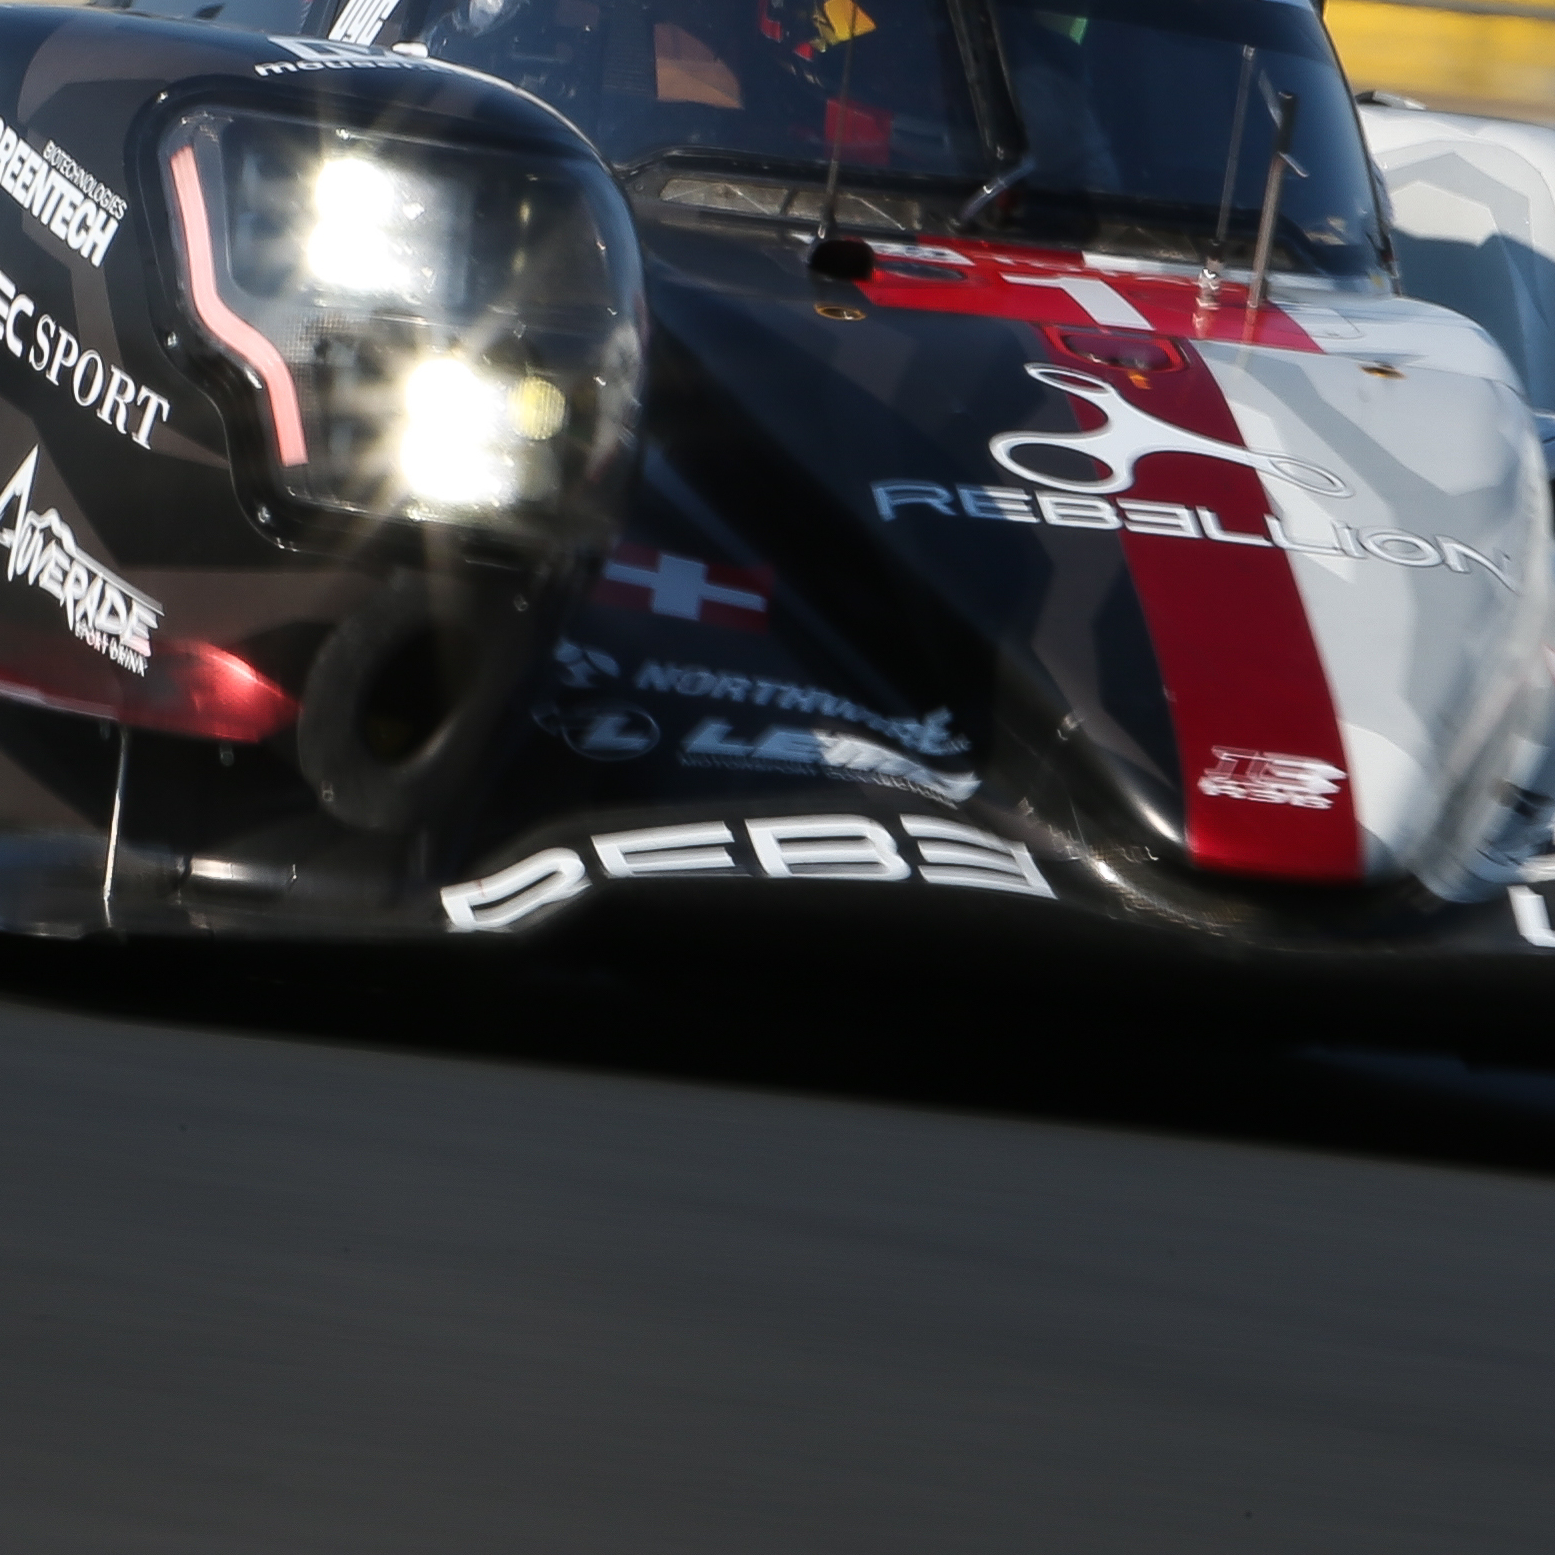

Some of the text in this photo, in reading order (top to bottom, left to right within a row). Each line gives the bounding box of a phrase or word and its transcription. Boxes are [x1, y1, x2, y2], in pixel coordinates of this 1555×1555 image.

[43, 139, 129, 221] BIOTECHNOLOGIES
[29, 313, 172, 451] SPORT
[869, 478, 1522, 596] REBELLION
